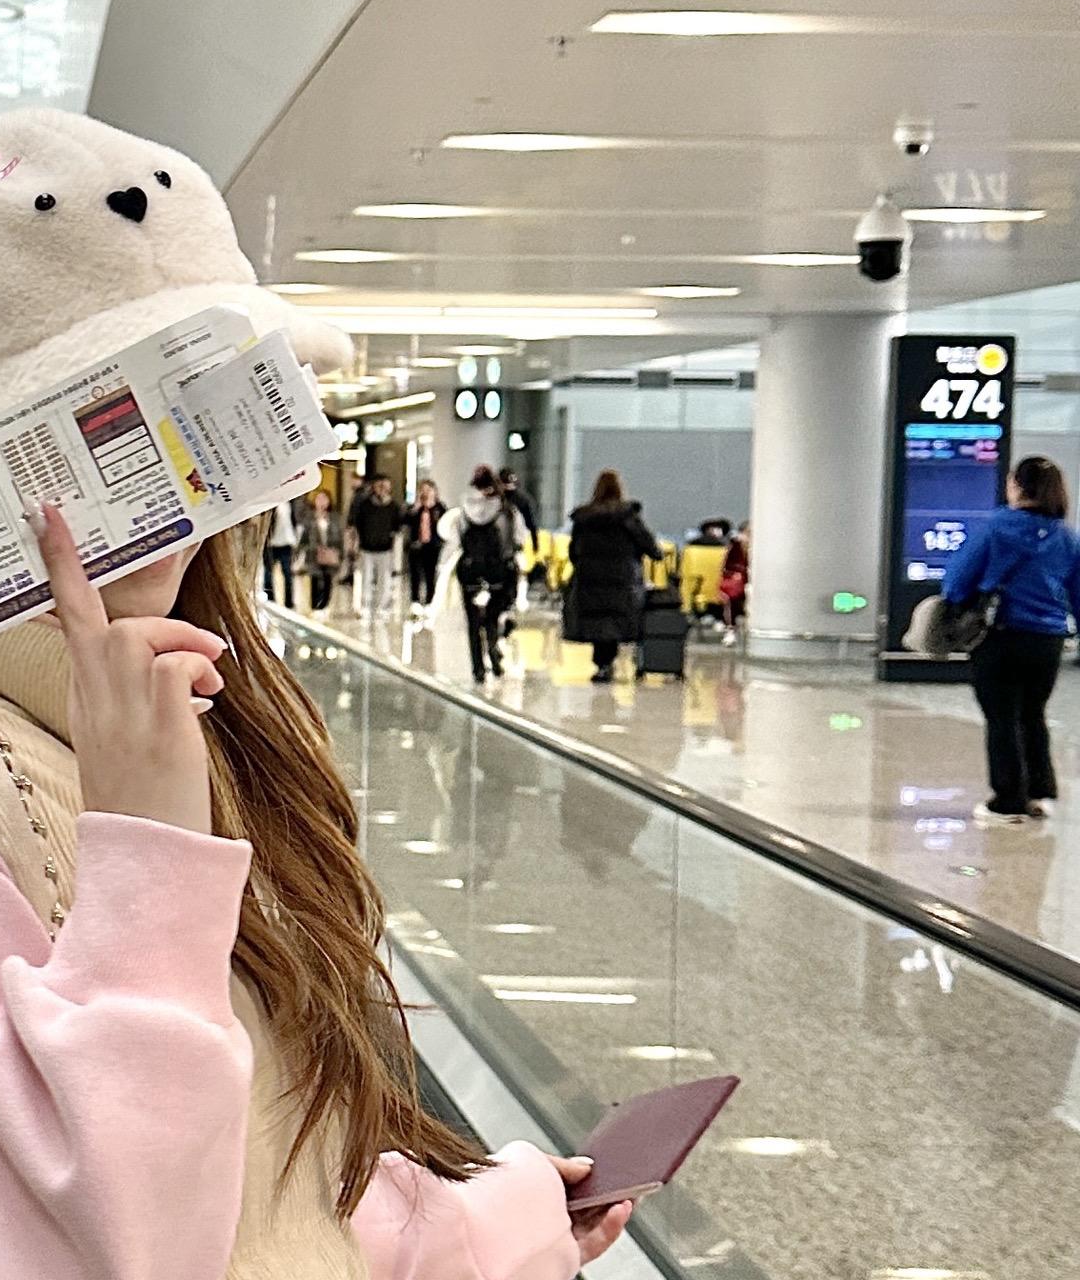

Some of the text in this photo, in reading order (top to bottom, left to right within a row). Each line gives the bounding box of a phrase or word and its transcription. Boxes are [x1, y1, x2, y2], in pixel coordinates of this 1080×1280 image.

[920, 379, 1005, 419] 474
[192, 412, 215, 448] AIRLINES
[211, 448, 231, 477] ASIANA
